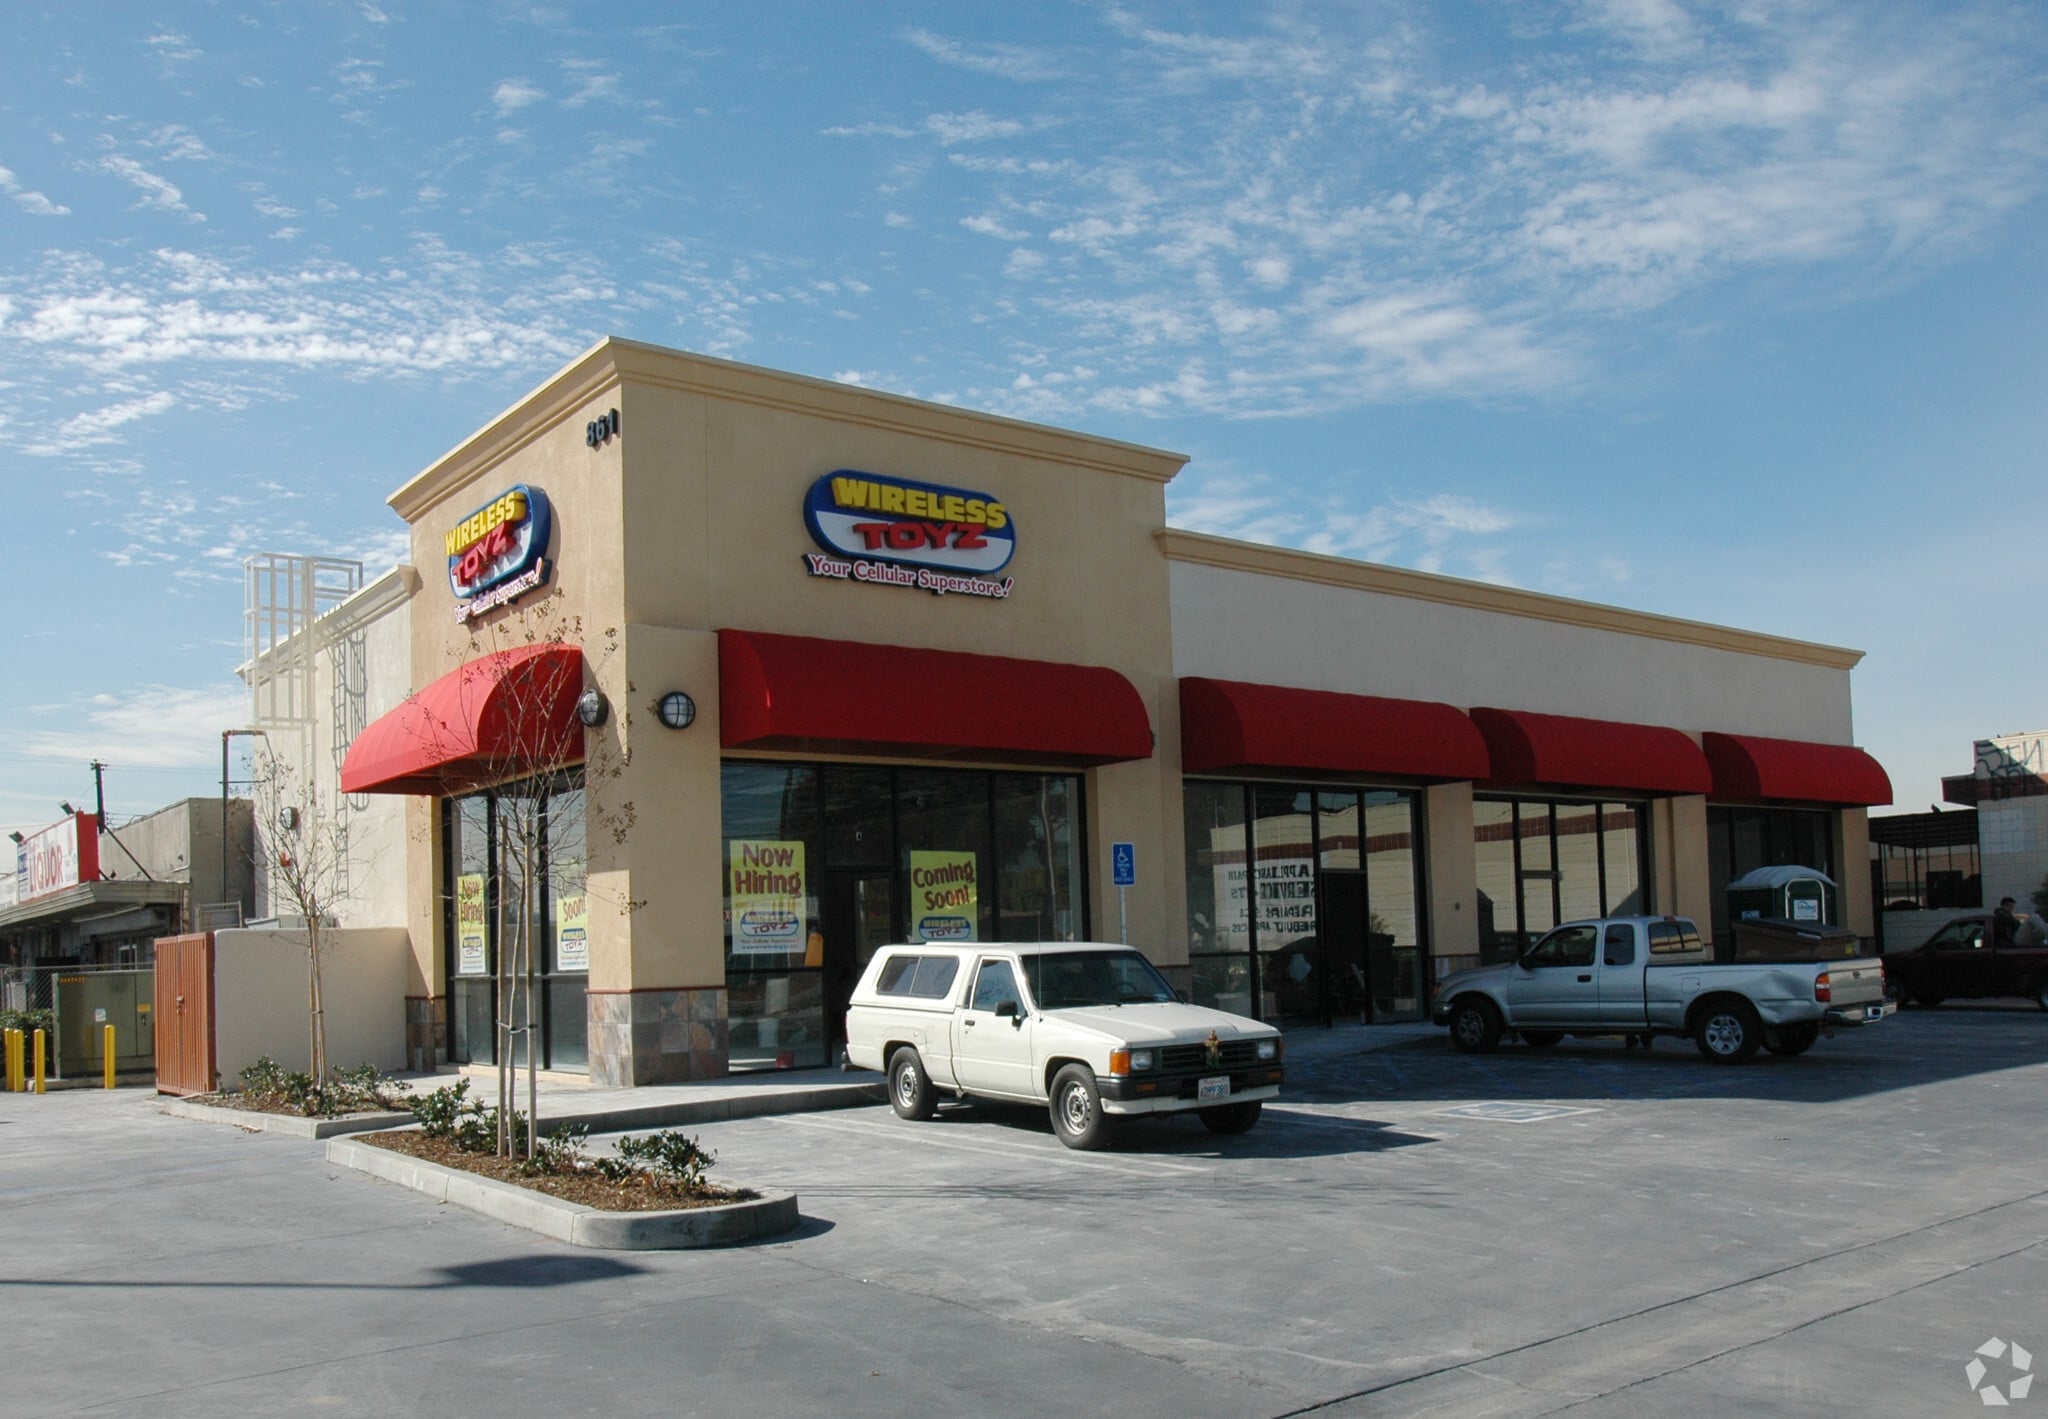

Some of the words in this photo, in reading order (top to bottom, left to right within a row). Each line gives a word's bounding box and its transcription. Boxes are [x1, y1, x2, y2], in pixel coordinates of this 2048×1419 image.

[586, 408, 617, 447] 861
[831, 477, 1007, 529] WIRELESS
[444, 491, 520, 556] WIRELESS
[852, 522, 988, 550] TOYZ
[452, 521, 512, 588] TOYZ
[809, 554, 849, 577] Your
[853, 560, 915, 586] Cellular
[918, 570, 1014, 597] Superstore!
[29, 845, 64, 893] LIQUOR
[742, 843, 794, 868] Now
[735, 869, 802, 898] Hiring
[912, 860, 976, 888] Coming
[751, 922, 789, 934] TOYZ
[928, 926, 961, 937] TOYZ
